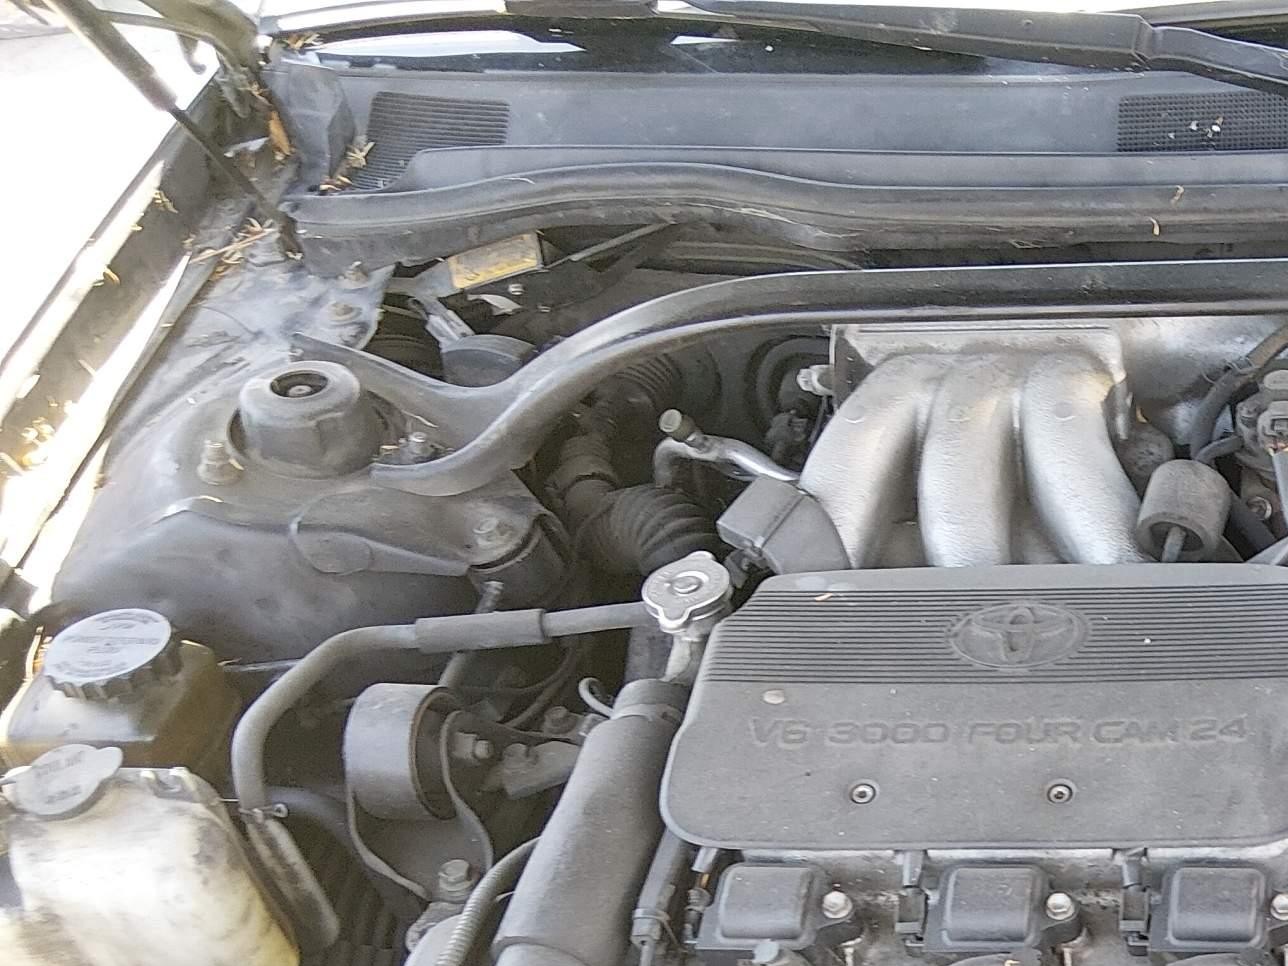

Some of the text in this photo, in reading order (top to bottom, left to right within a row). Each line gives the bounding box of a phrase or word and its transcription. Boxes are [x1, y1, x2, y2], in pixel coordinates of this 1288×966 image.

[752, 717, 810, 747] V6
[827, 720, 951, 746] 3000
[967, 719, 1082, 745] FOUR
[1187, 715, 1250, 743] 24
